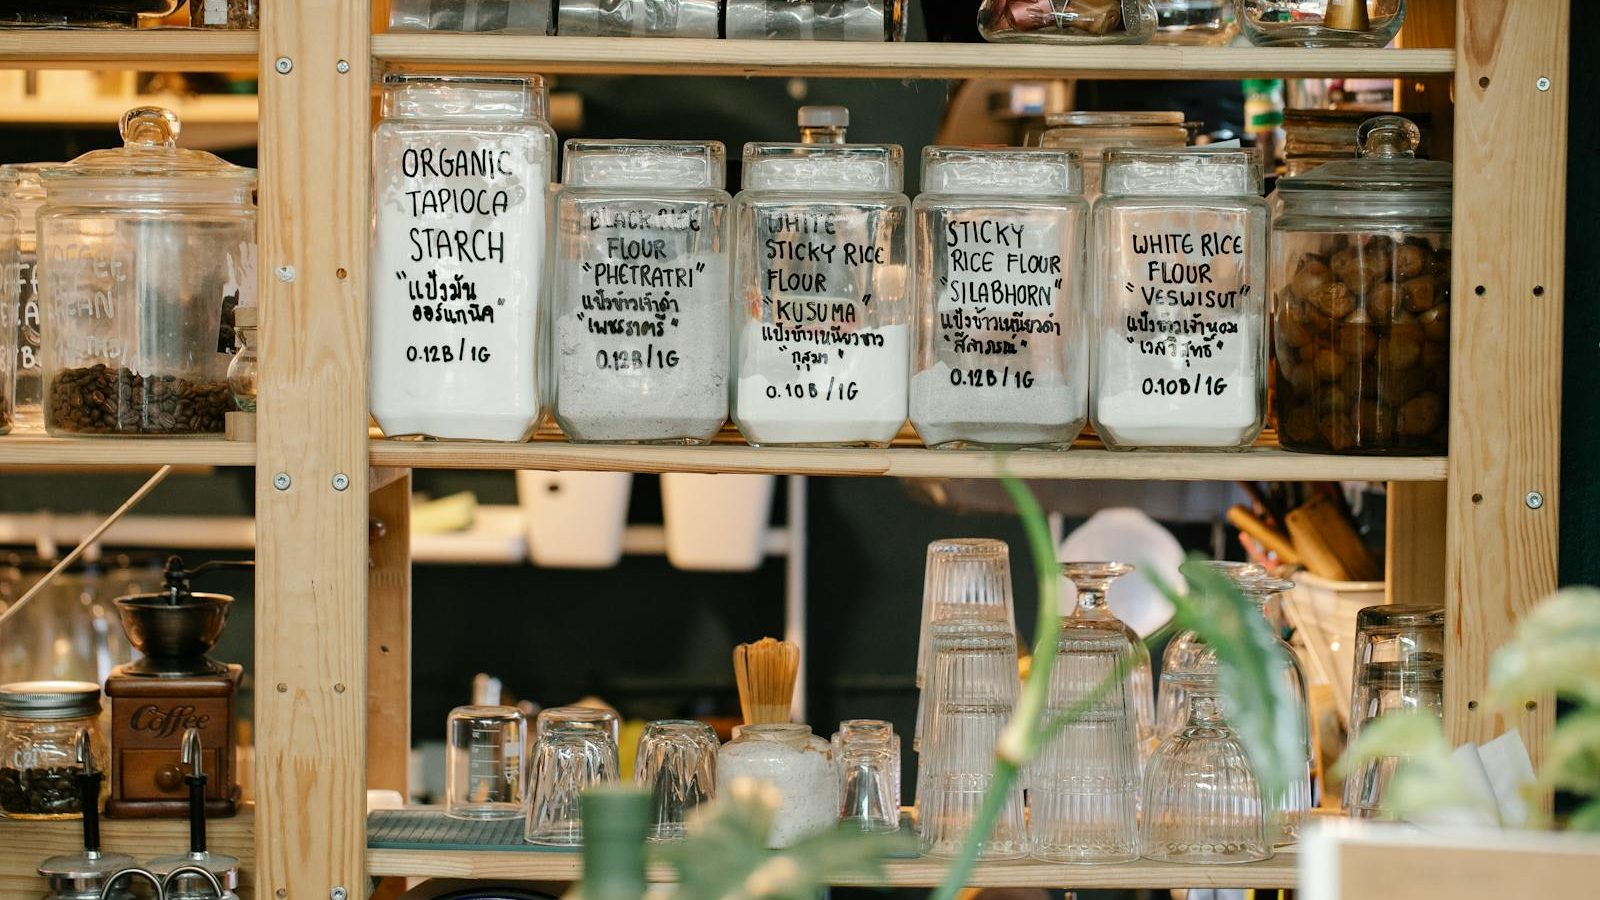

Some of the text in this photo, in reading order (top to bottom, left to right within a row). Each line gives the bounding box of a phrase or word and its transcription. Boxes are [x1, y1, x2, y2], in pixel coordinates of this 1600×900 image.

[402, 148, 513, 179] ORGANIC
[405, 188, 508, 216] TAPIOCA
[768, 213, 836, 235] WHITE
[947, 220, 1024, 248] STICKY
[409, 228, 504, 263] STARCH
[606, 237, 667, 260] FLOUR
[765, 238, 885, 266] STICKY RICE
[1132, 231, 1243, 257] WHITE RICE
[582, 262, 705, 288] "PHETRATRI"
[950, 249, 1061, 274] RICE FLOUR
[1148, 260, 1213, 284] FLOUR
[767, 268, 827, 292] FLOUR
[939, 276, 1063, 307] "SILABHORN"
[130, 704, 210, 738] Coffee
